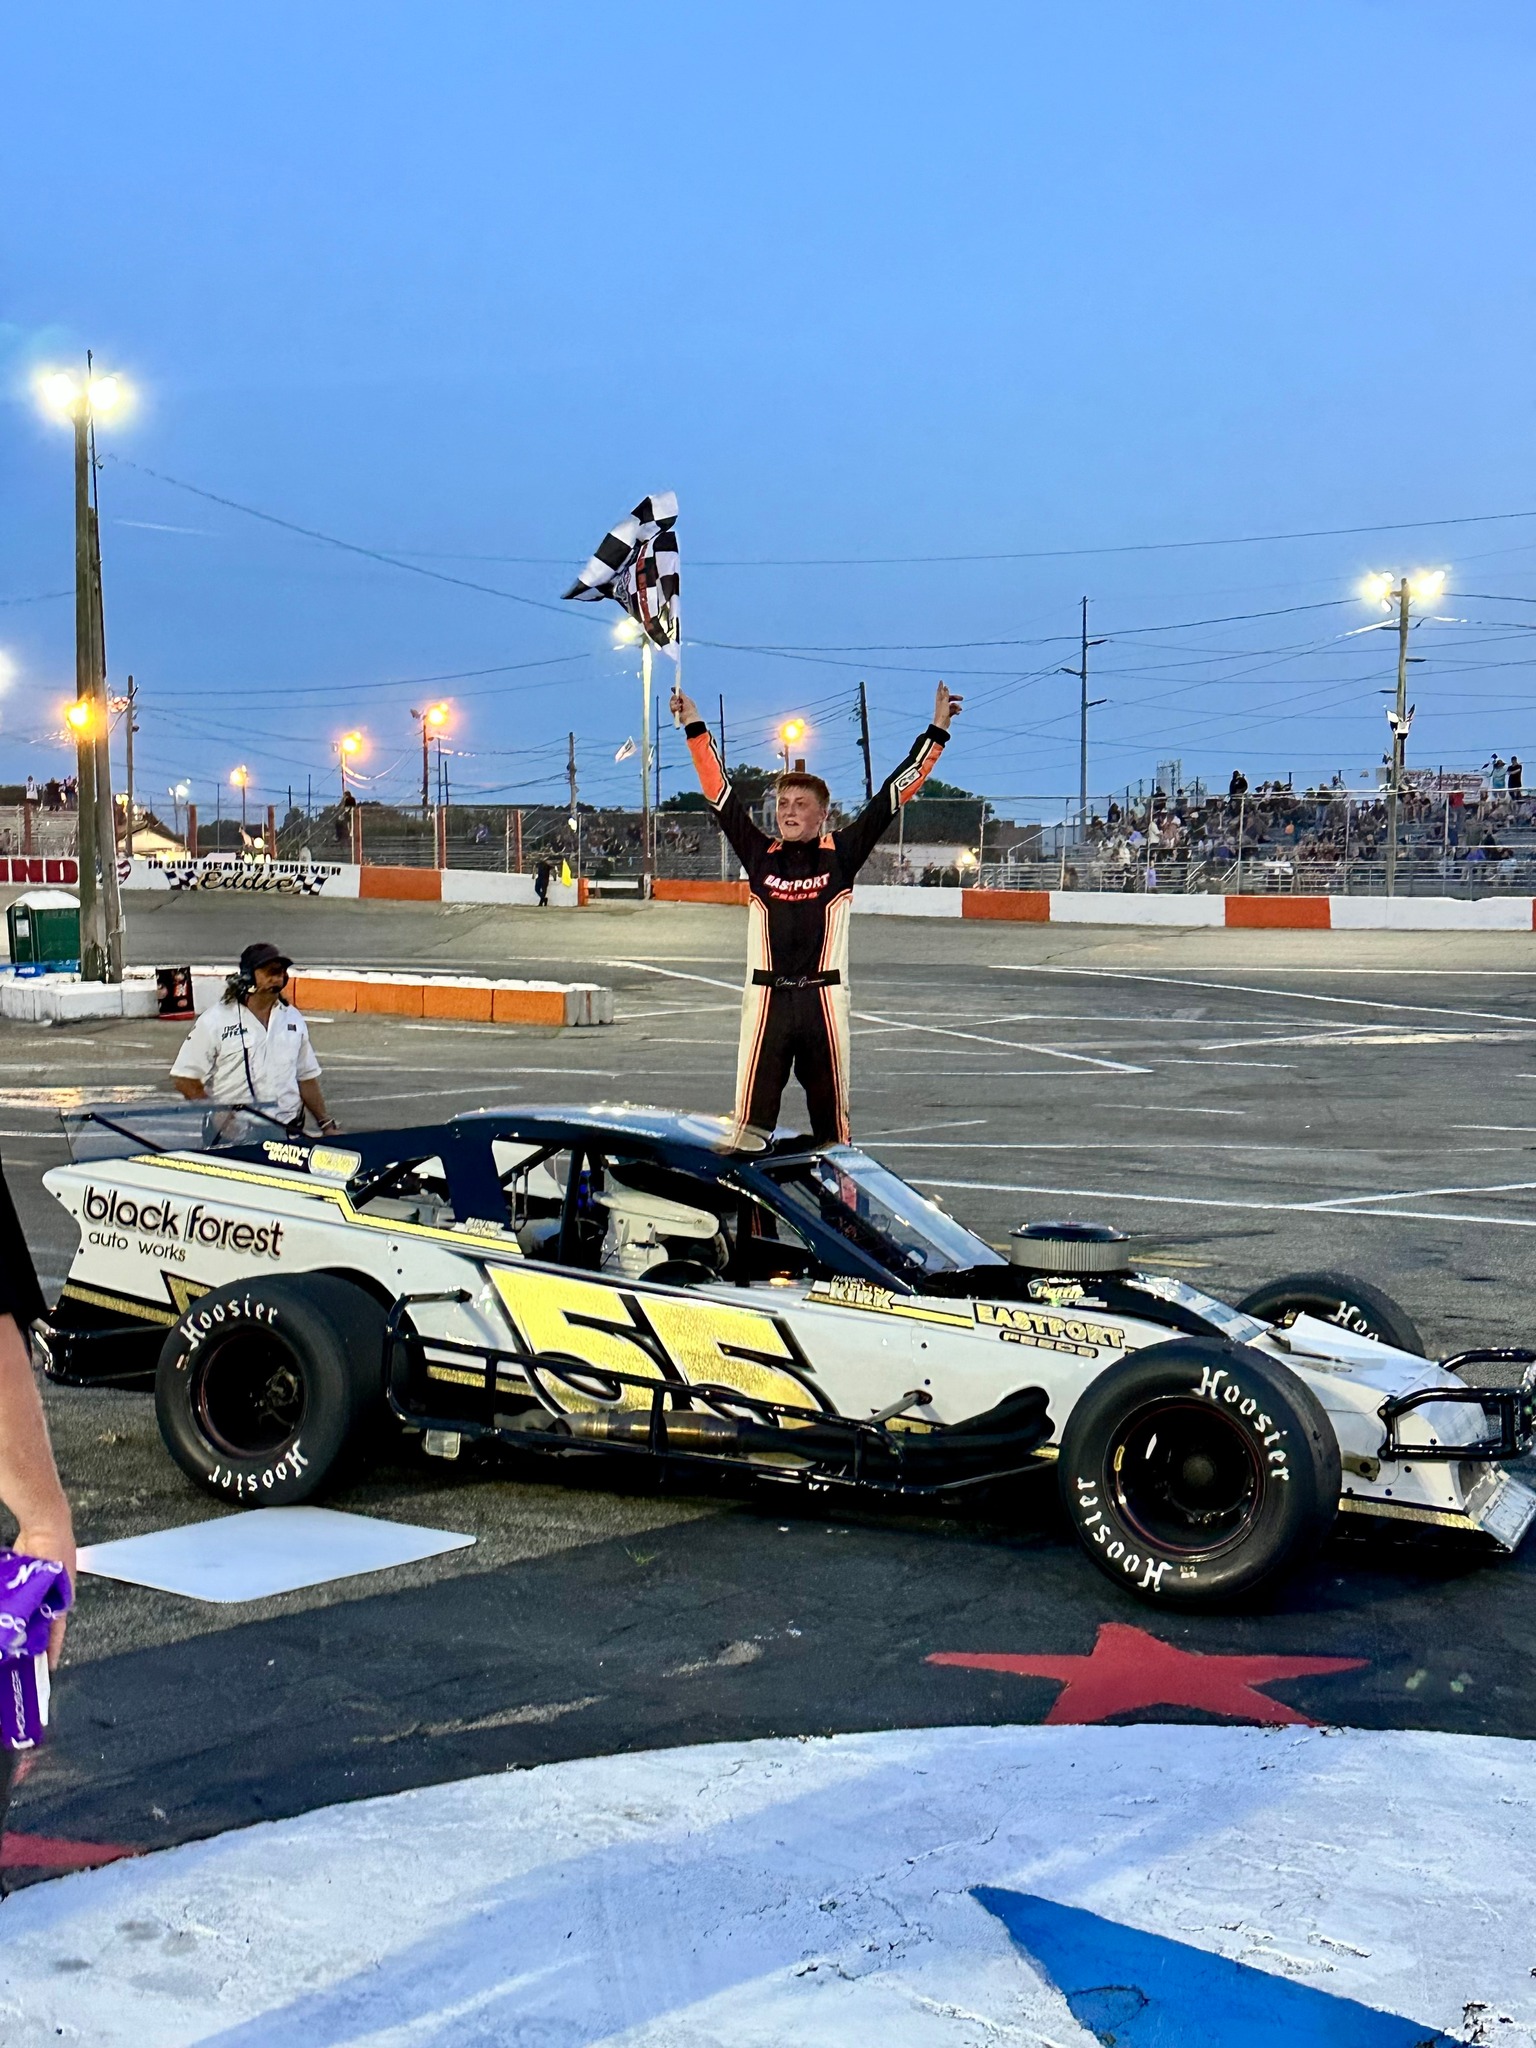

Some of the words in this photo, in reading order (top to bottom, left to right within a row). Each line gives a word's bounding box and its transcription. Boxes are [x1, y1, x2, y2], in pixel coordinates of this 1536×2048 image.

[200, 870, 300, 892] Eddie
[763, 873, 830, 891] EASTPORT
[83, 1185, 179, 1240] black
[184, 1205, 284, 1260] forest
[88, 1231, 129, 1250] auto
[138, 1240, 186, 1262] works
[180, 1293, 278, 1351] Hoosier
[486, 1261, 838, 1432] 55
[973, 1303, 1125, 1349] EASTPORT
[1191, 1365, 1290, 1481] Hoosier
[208, 1439, 309, 1498] Hoosier
[1077, 1476, 1173, 1592] Hoosier
